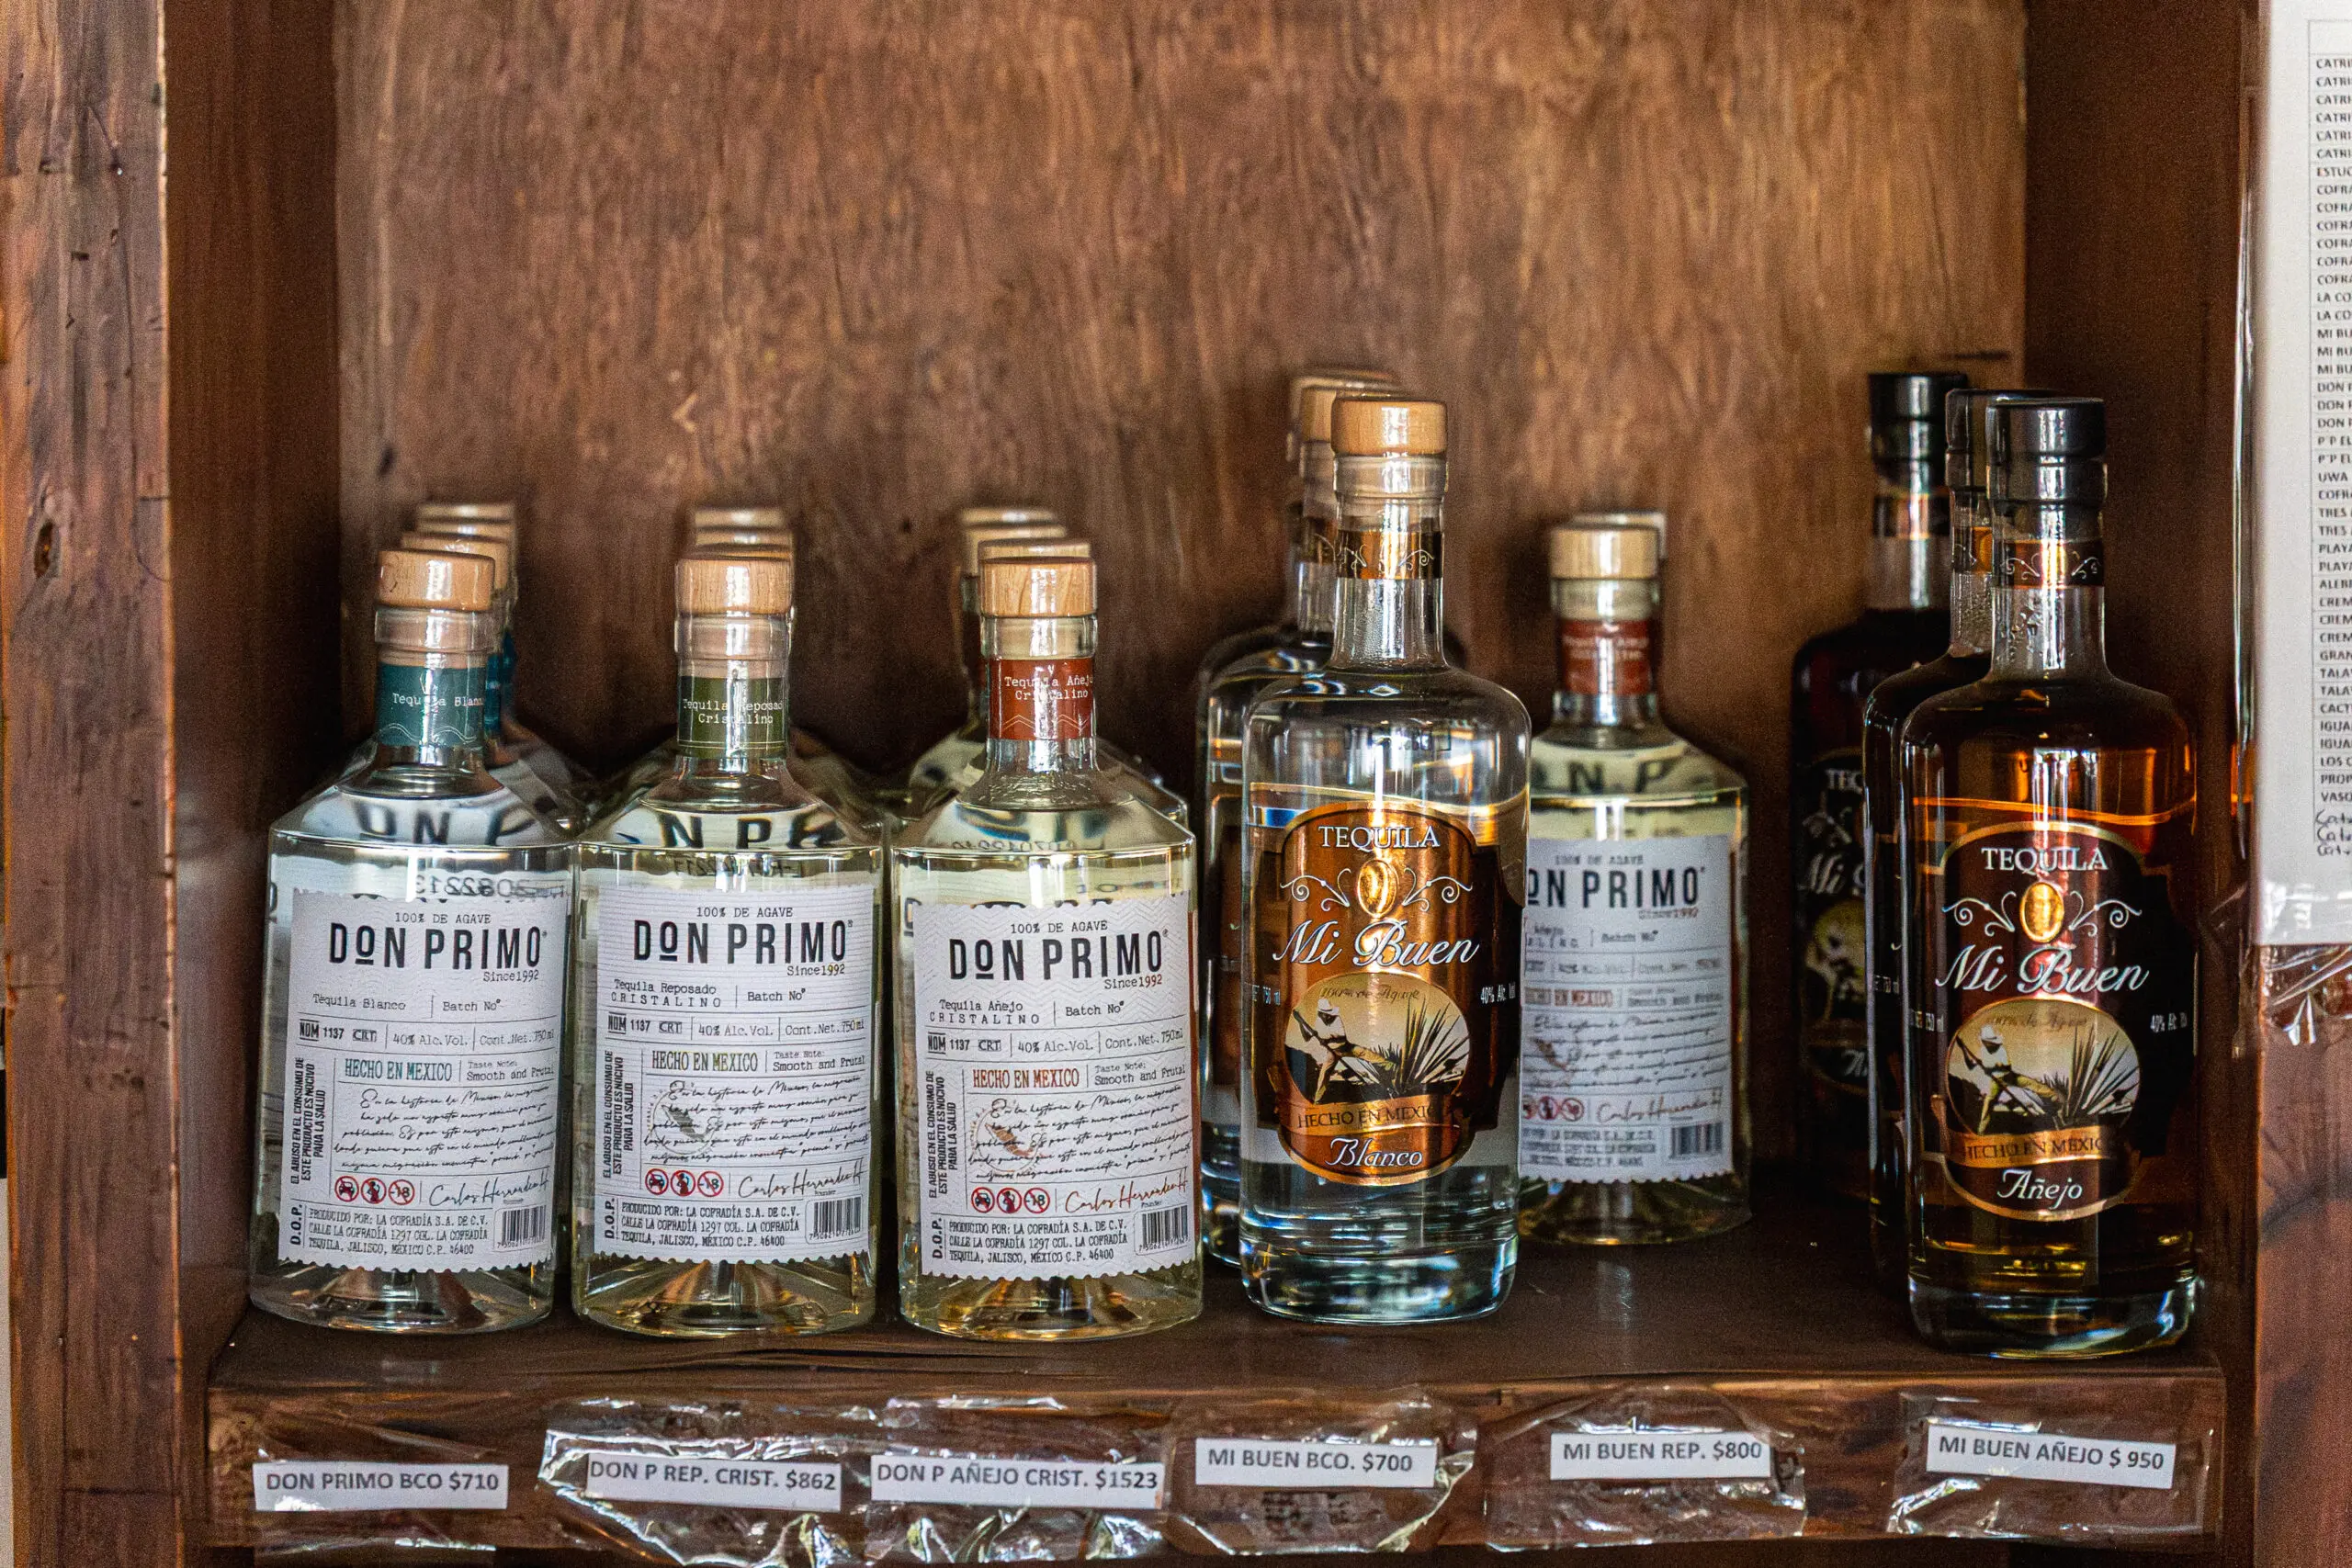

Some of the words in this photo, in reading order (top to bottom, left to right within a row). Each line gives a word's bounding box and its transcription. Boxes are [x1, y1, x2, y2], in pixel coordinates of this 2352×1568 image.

[2317, 310, 2332, 321] LA
[2317, 365, 2333, 374] MI
[2317, 418, 2345, 428] DON
[2318, 472, 2348, 482] UWA
[2319, 508, 2346, 517] TRES
[1005, 676, 1058, 689] Tequla
[392, 693, 447, 707] Tequa
[1015, 688, 1088, 699] Cralino
[2321, 757, 2342, 766] LOS
[1317, 826, 1441, 852] TEQUILA
[1981, 847, 2109, 874] TEQUILA
[1528, 869, 1566, 908] ON
[1583, 867, 1699, 908] PRIMO
[395, 912, 425, 923] 100%
[433, 914, 447, 924] DE
[455, 914, 492, 924] AGAVE
[696, 907, 727, 918] 100%
[734, 908, 750, 919] DE
[757, 907, 793, 918] AGAVE
[1010, 923, 1041, 934] 100%
[1048, 922, 1064, 933] DE
[1071, 919, 1108, 932] AGAVE
[329, 922, 406, 968] DON
[633, 919, 708, 964] DON
[1272, 919, 1342, 964] Mi
[1352, 919, 1480, 967] Buen
[949, 938, 1024, 981] DON
[1935, 945, 2007, 992] Mi
[2017, 945, 2150, 994] Buen
[614, 979, 654, 992] Tequila
[661, 983, 717, 995] Reposado
[312, 993, 356, 1008] Tequila
[363, 998, 406, 1010] Blanco
[747, 991, 783, 1001] Batch
[443, 1001, 478, 1011] Batch
[939, 998, 981, 1012] Tequila
[988, 1000, 1023, 1013] Añejo
[1066, 1006, 1102, 1016] Batch
[630, 1019, 650, 1032] 1137
[698, 1024, 719, 1036] 40%
[950, 1039, 969, 1050] 1137
[1017, 1042, 1040, 1054] 40%
[345, 1058, 383, 1078] HECHO
[387, 1061, 402, 1079] EN
[406, 1061, 453, 1081] MEXICO
[651, 1050, 689, 1071] HECHO
[693, 1051, 709, 1071] EN
[712, 1050, 758, 1072] MEXICO
[773, 1061, 812, 1071] Smooth
[818, 1059, 835, 1069] and
[925, 1070, 934, 1083] DE
[972, 1069, 1010, 1089] HECHO
[1013, 1069, 1029, 1089] EN
[1033, 1067, 1080, 1089] MEXICO
[1094, 1073, 1134, 1086] Smooth
[1140, 1070, 1157, 1081] and
[935, 1077, 945, 1110] NOCIVO
[926, 1084, 935, 1128] CONSUMO
[936, 1111, 945, 1122] ES
[946, 1101, 956, 1132] SALUD
[1298, 1111, 1354, 1128] HECHO
[1359, 1109, 1379, 1123] EN
[1386, 1105, 1430, 1121] MEXI
[927, 1130, 935, 1141] EL
[947, 1134, 957, 1145] LA
[928, 1142, 936, 1155] EN
[936, 1123, 947, 1170] PRODUCTO
[1325, 1137, 1423, 1167] Blanco
[2052, 1137, 2102, 1155] MEXIC
[947, 1147, 957, 1170] PARA
[928, 1156, 937, 1186] ABUSO
[937, 1171, 947, 1194] ESTE
[1997, 1168, 2083, 1210] Añejo
[290, 1205, 303, 1246] D.O.P.
[604, 1198, 616, 1240] D.O.P.
[992, 1224, 1011, 1234] POR:
[1013, 1224, 1024, 1235] LA
[1073, 1222, 1092, 1233] S.A.
[1095, 1221, 1106, 1231] DE
[1108, 1219, 1126, 1230] C.V.
[932, 1217, 944, 1259] D.O.P.
[973, 1237, 983, 1247] LA
[1029, 1238, 1050, 1250] 1297
[1052, 1237, 1072, 1248] COL.
[1075, 1237, 1086, 1247] LA
[1066, 1251, 1086, 1262] C.P.
[1089, 1248, 1114, 1260] 46400
[1563, 1440, 1591, 1459] MI
[1597, 1439, 1655, 1460] BUEN
[1661, 1439, 1706, 1460] REP.
[1712, 1438, 1762, 1462] $800
[1939, 1435, 1966, 1455] MI
[1973, 1438, 2030, 1461] BUEN
[2035, 1438, 2104, 1466] AÑEJO
[2109, 1444, 2123, 1470] $
[2127, 1450, 2164, 1471] 950
[1208, 1448, 1236, 1466] MI
[1241, 1449, 1301, 1469] BUEN
[1306, 1451, 1357, 1472] BCO.
[1362, 1451, 1413, 1474] $700
[266, 1472, 315, 1492] DON
[321, 1472, 394, 1492] PRIMO
[399, 1471, 443, 1491] BCO
[448, 1471, 499, 1494] $710
[590, 1460, 639, 1480] DON
[645, 1462, 658, 1482] P
[664, 1463, 709, 1484] REP.
[716, 1467, 780, 1489] CRIST.
[786, 1469, 836, 1494] $862
[877, 1462, 926, 1483] DON
[932, 1465, 944, 1483] P
[951, 1461, 1019, 1486] AÑEJO
[1025, 1467, 1091, 1489] CRIST.
[1095, 1468, 1159, 1492] $1523
